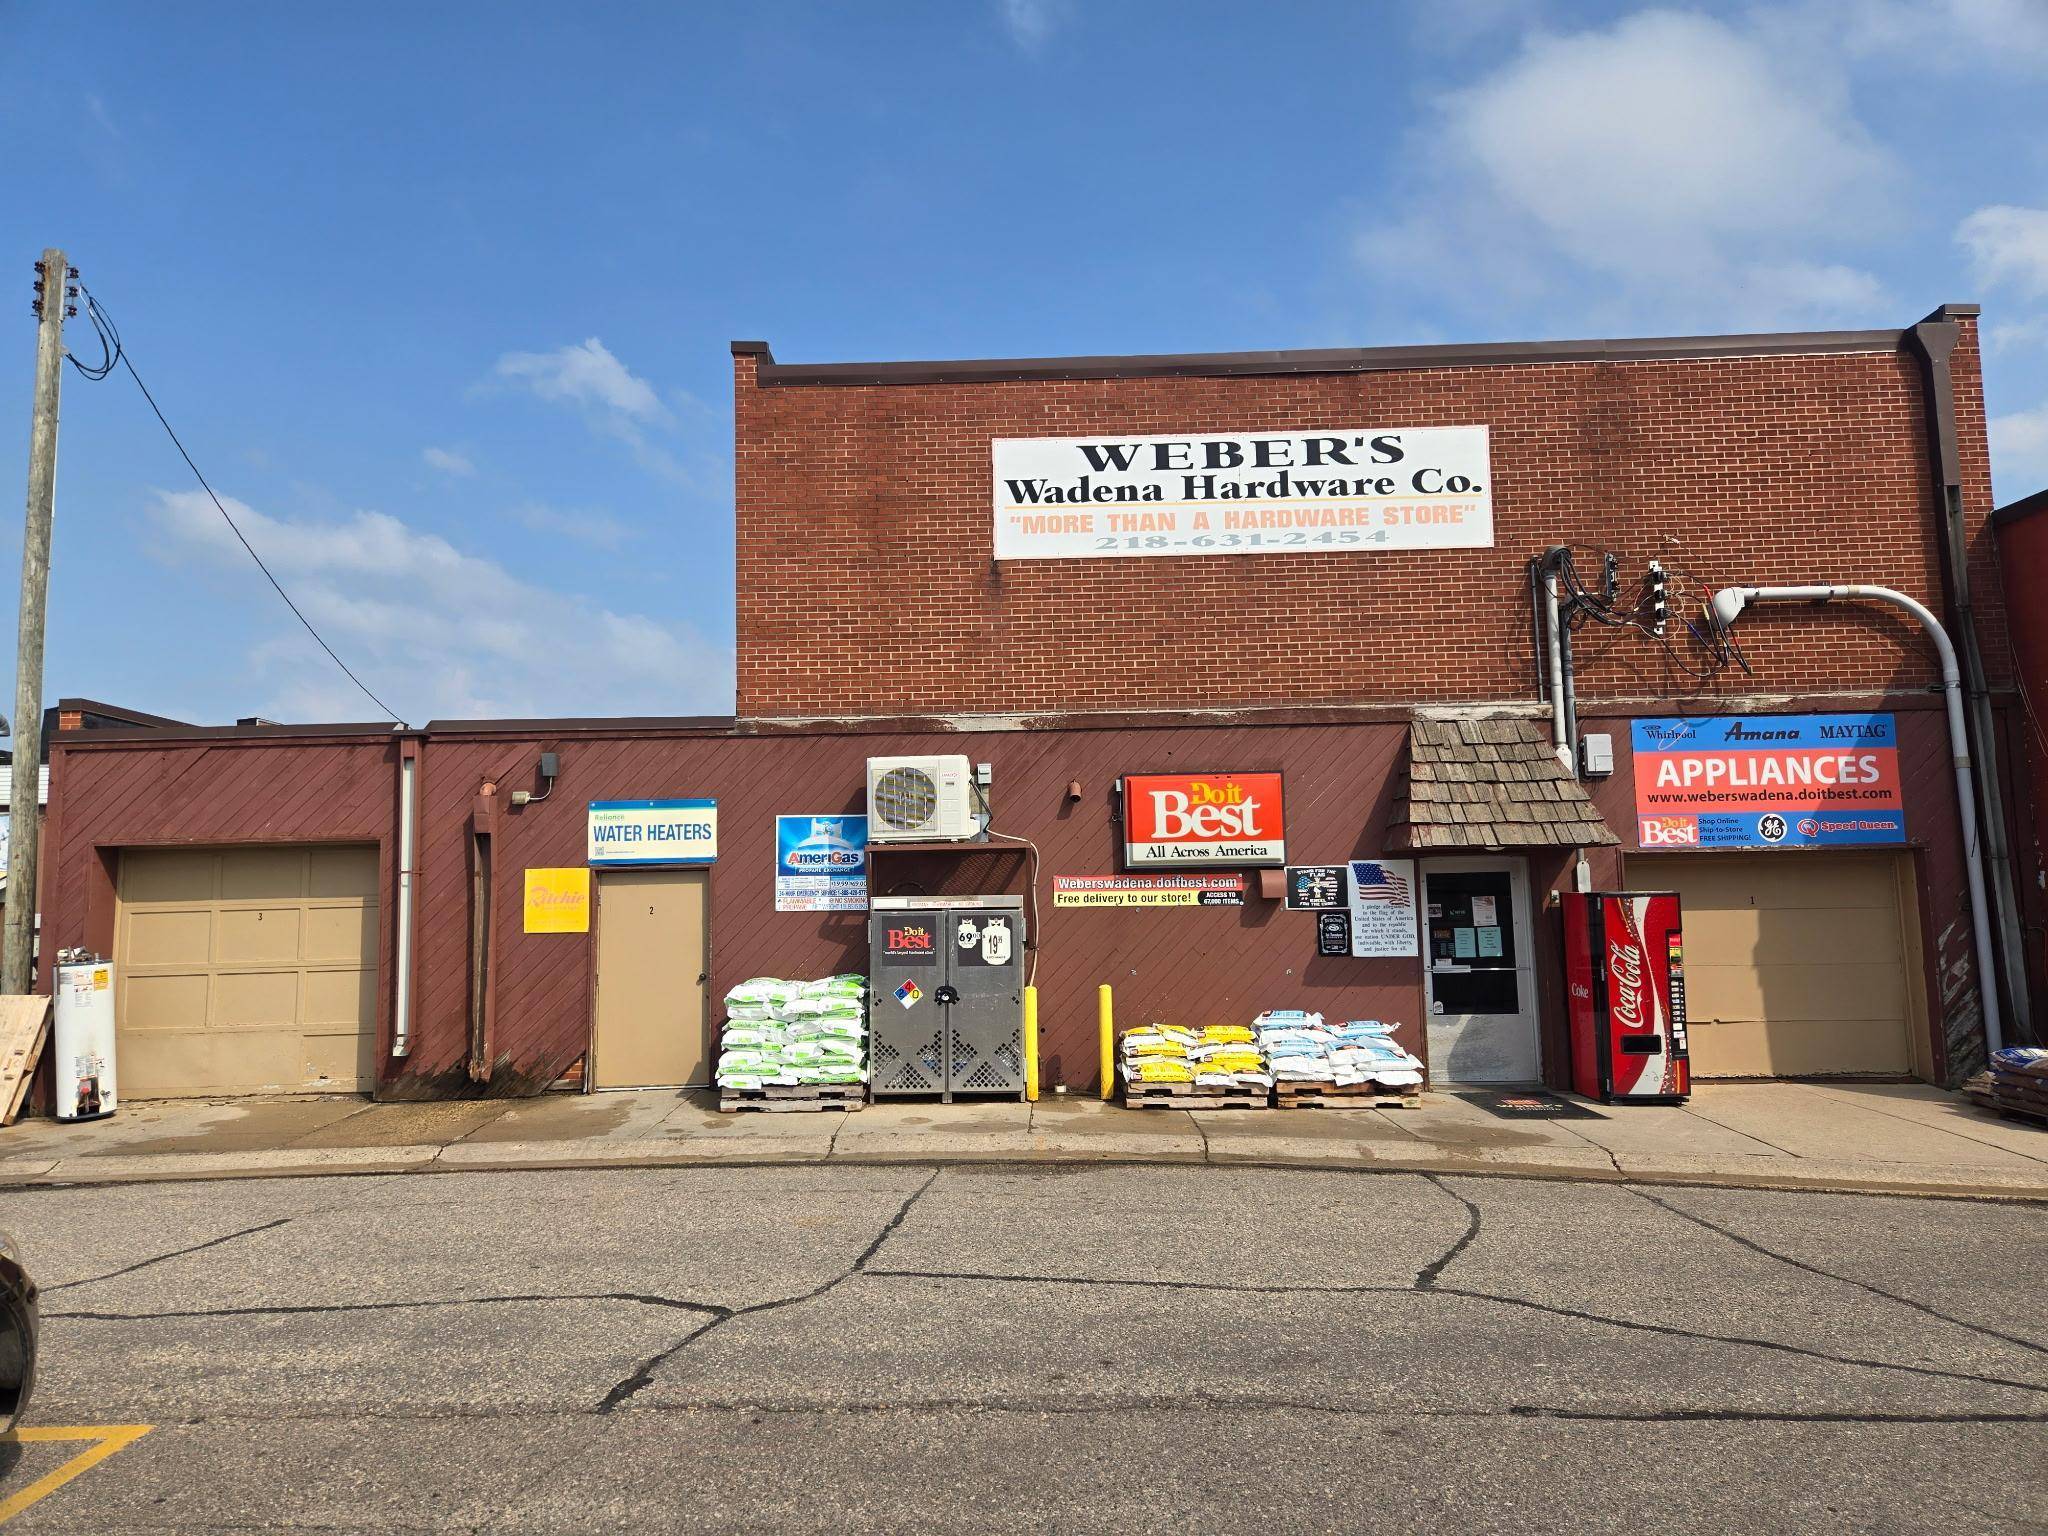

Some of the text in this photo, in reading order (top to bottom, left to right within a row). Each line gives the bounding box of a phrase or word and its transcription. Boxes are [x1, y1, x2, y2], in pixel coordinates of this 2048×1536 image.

[1076, 436, 1404, 472] WEBER'S
[1004, 468, 1483, 504] Wadena Hardware Co.
[1010, 504, 1477, 535] "MORE THAN A HARDWARE STORE"
[1095, 529, 1390, 551] 218-631-2454
[1646, 729, 1697, 742] Whirlpool
[1723, 721, 1800, 742] Amana
[1819, 724, 1888, 739] MAYTAG
[1656, 755, 1880, 788] APPLIANCES
[1190, 782, 1243, 805] Do it
[1647, 787, 1892, 804] www.weberswadena.doitbest.com
[1148, 790, 1264, 839] Best
[1662, 816, 1688, 828] Do it
[593, 823, 712, 842] WATER HEATERS
[1642, 820, 1698, 845] Best
[1821, 820, 1857, 832] Speed
[1859, 820, 1895, 830] Queen
[787, 851, 859, 865] AmeriGas
[1146, 844, 1268, 858] All Across America
[1058, 876, 1237, 890] Weberswadena.doitbest.com
[1057, 892, 1191, 905] Free delivery to our store!
[1749, 896, 1755, 905] 1
[258, 912, 263, 921] 3
[649, 906, 654, 915] 2
[887, 929, 932, 949] Best
[903, 926, 925, 936] Do it
[959, 932, 973, 942] 69
[988, 935, 998, 955] 19
[904, 982, 911, 991] 4
[1571, 982, 1589, 999] Coke
[1609, 937, 1645, 1029] Coca-Cola
[912, 989, 920, 999] 0
